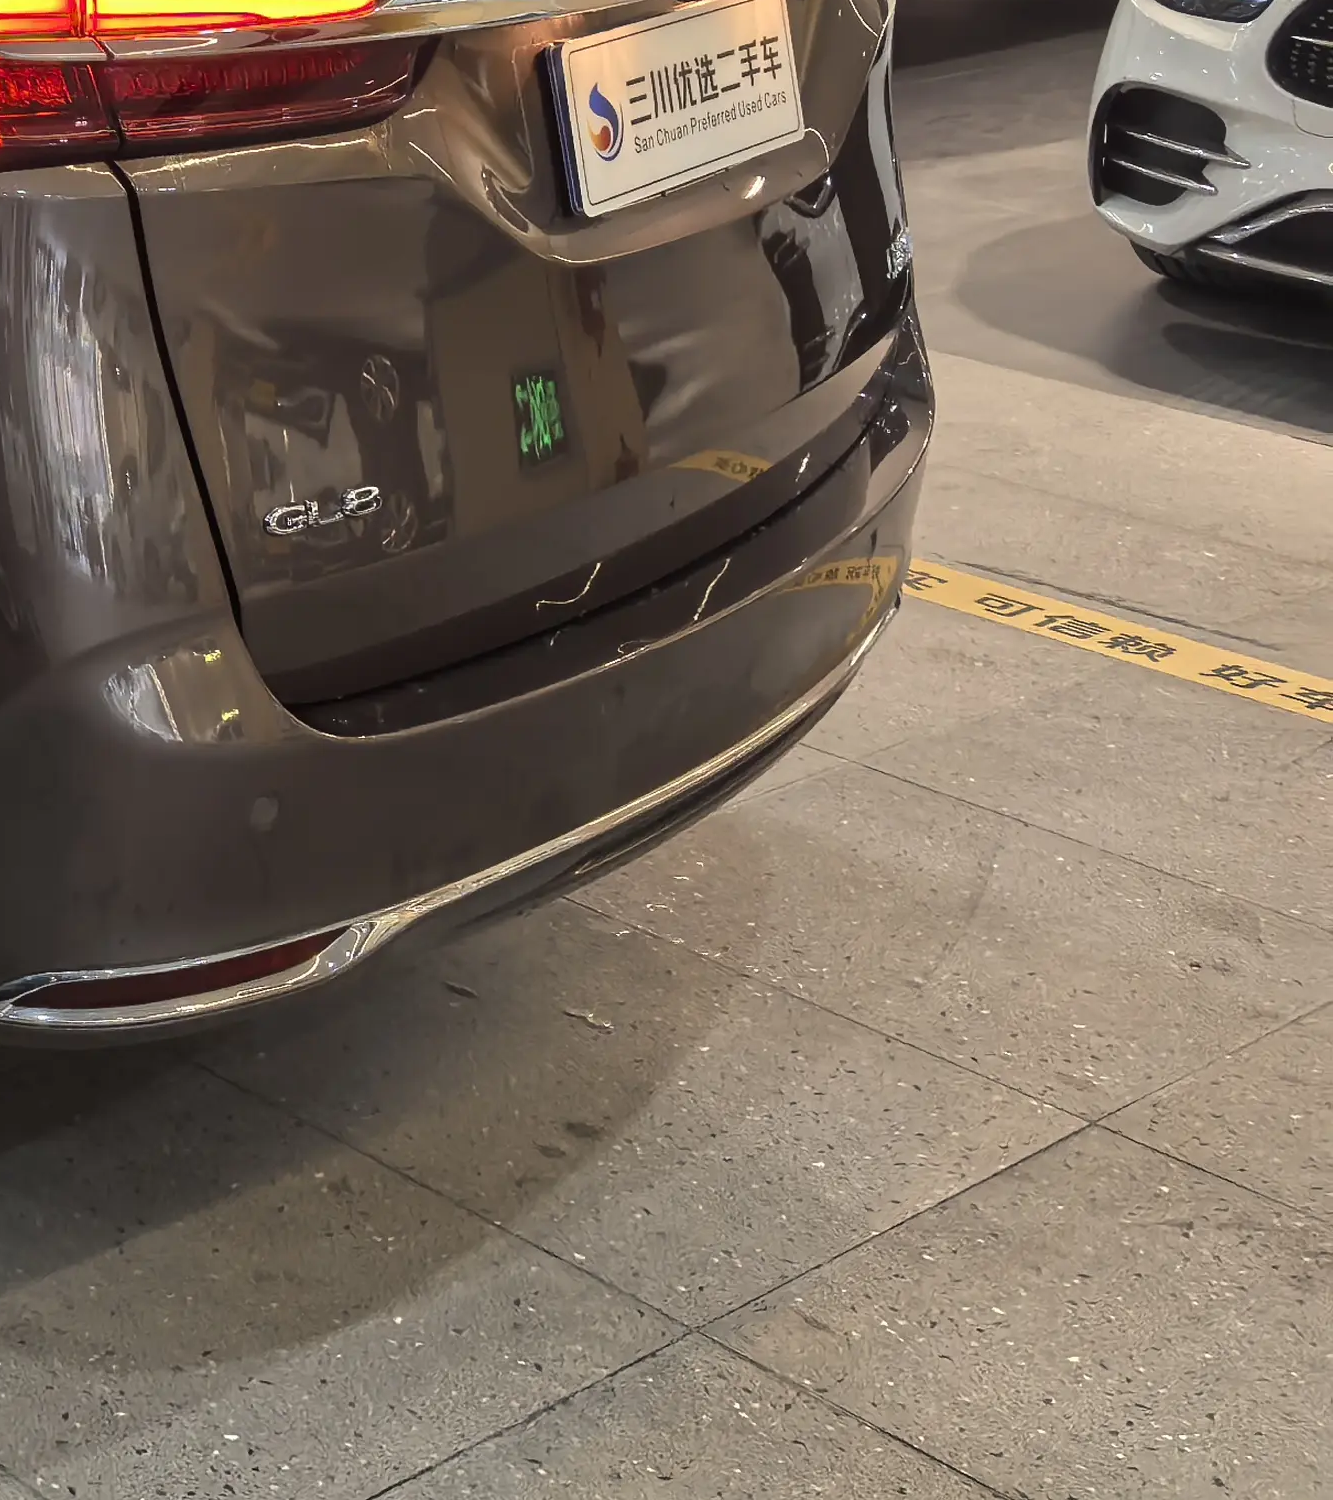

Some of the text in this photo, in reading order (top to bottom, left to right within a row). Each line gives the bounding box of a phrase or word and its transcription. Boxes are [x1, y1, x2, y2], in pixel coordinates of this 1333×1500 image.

[626, 36, 782, 125] 三川优选二手车
[634, 90, 787, 154] San Chuan Preferred Used Cars
[262, 485, 383, 536] GL8
[973, 593, 1177, 662] 可信赖
